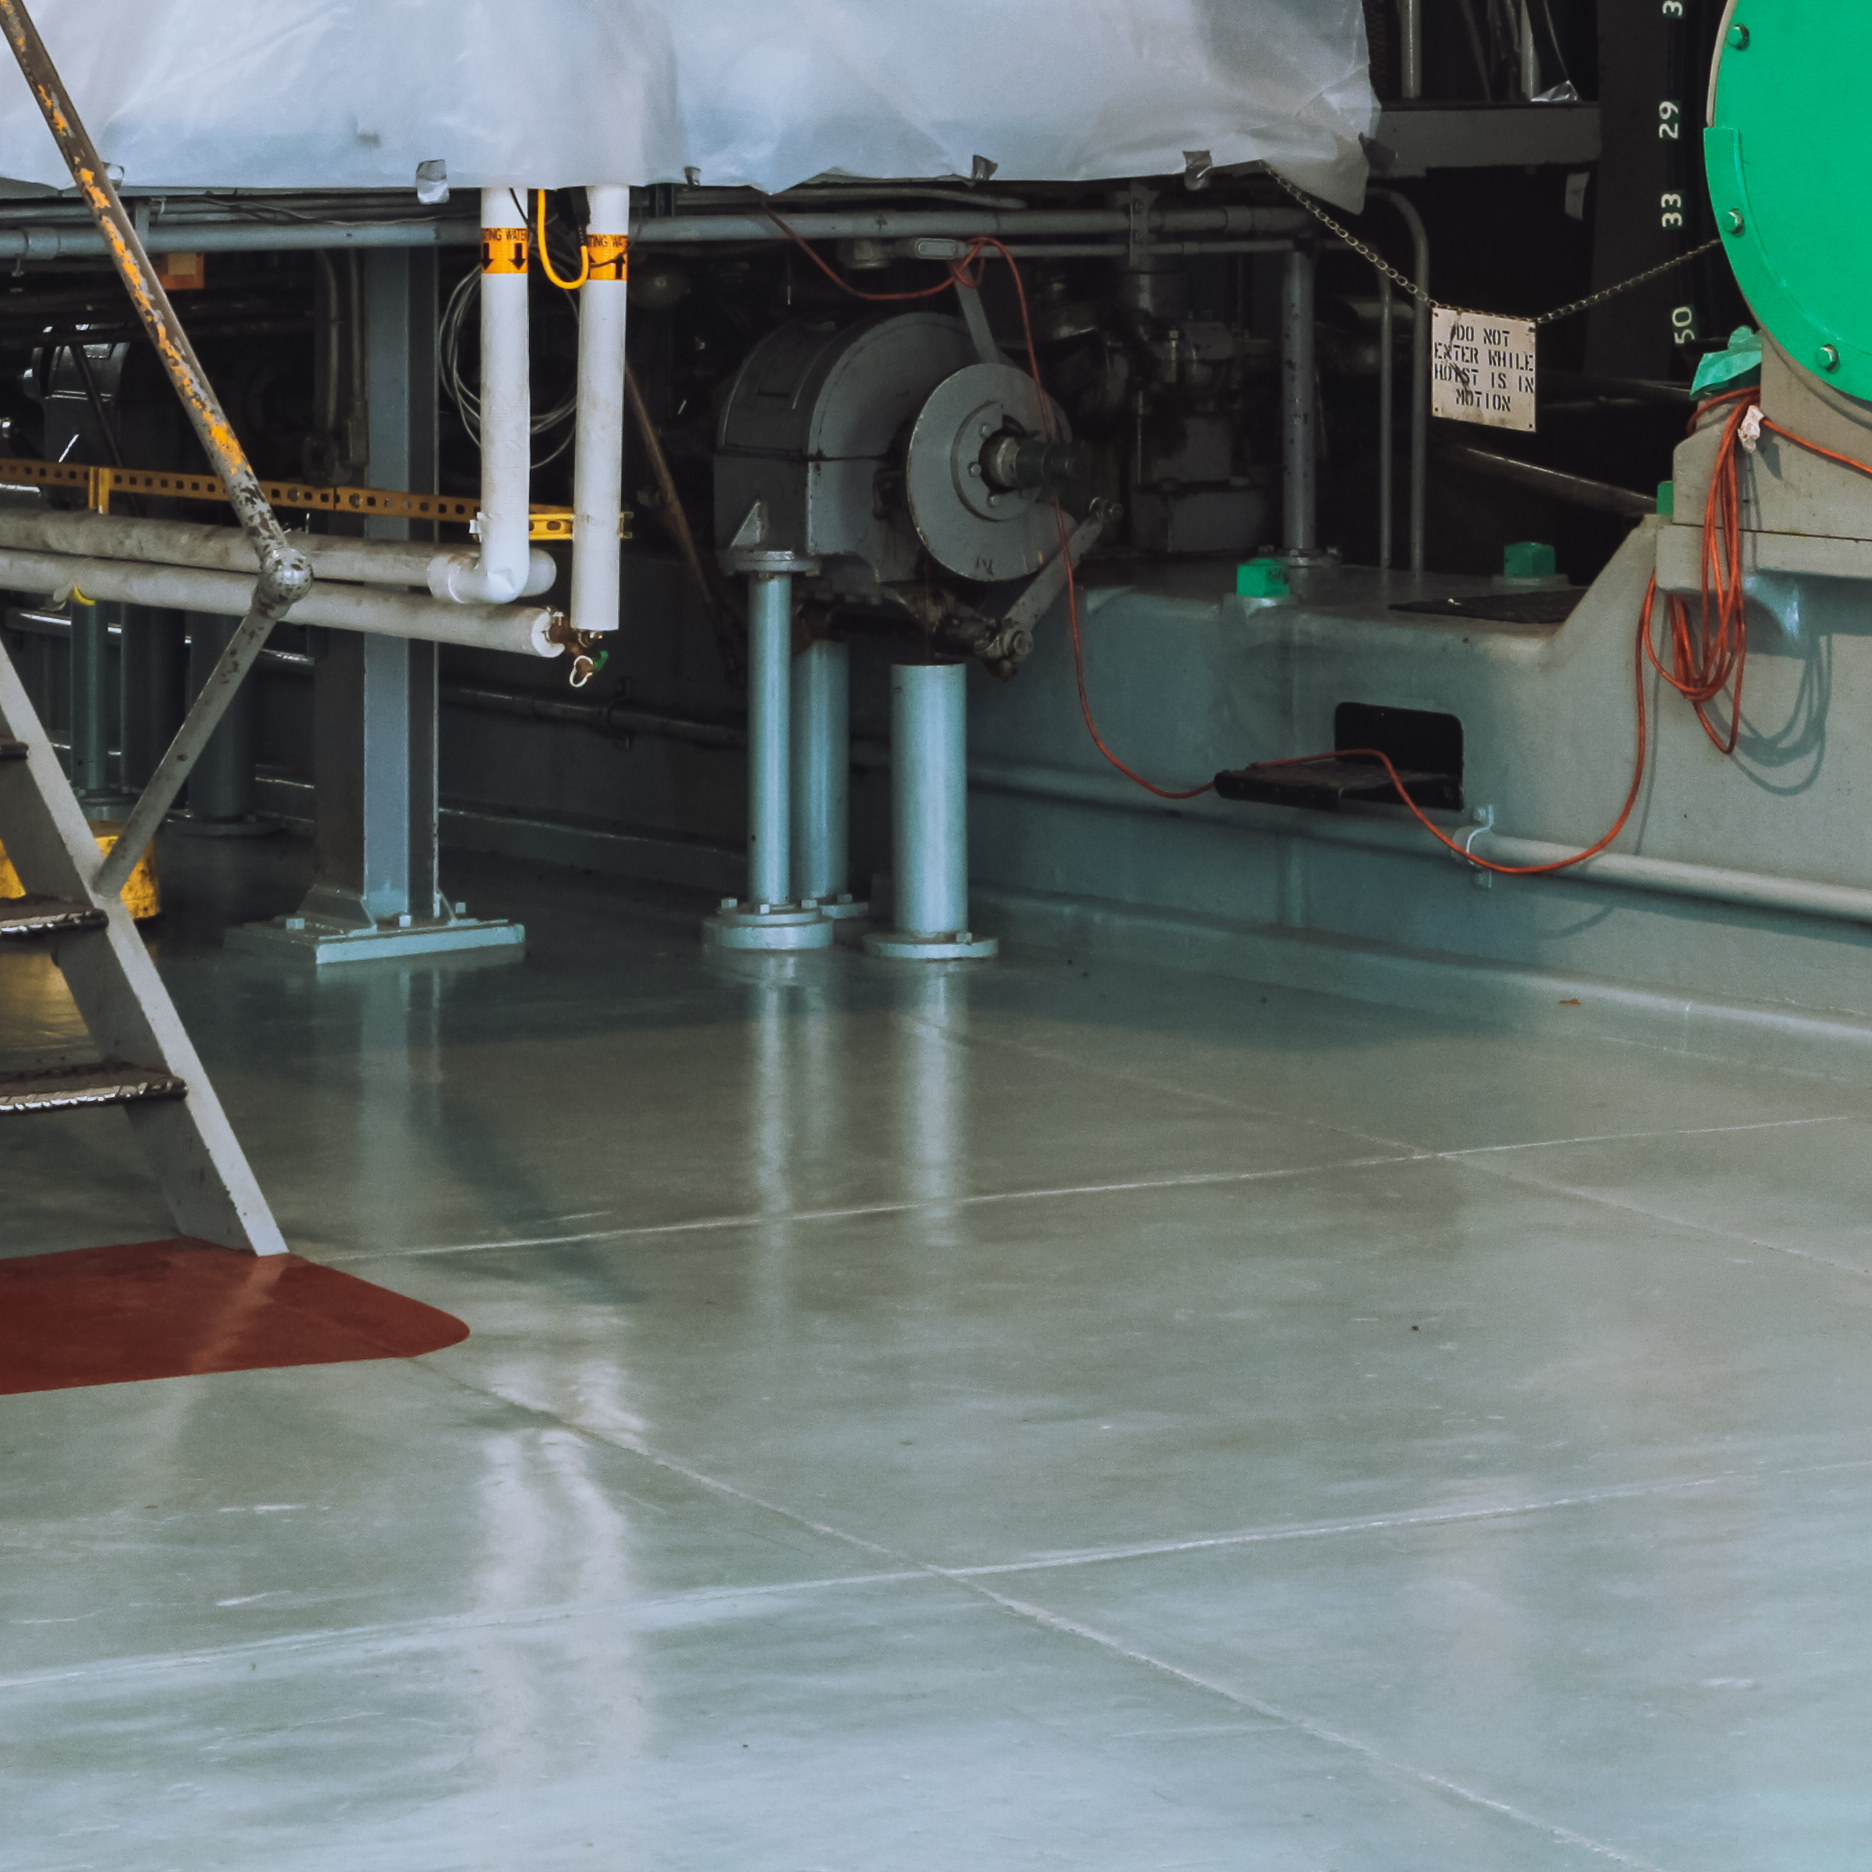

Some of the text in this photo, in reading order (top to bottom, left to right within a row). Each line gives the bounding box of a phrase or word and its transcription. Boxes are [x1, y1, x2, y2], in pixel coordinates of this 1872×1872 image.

[1659, 101, 1680, 139] 29
[1661, 192, 1682, 228] 33
[1457, 324, 1510, 347] DO NOT
[1672, 306, 1696, 345] 50
[1435, 342, 1534, 372] ENTER WHILE
[1435, 364, 1534, 393] HOIST IS IN
[1456, 389, 1510, 412] MOTION
